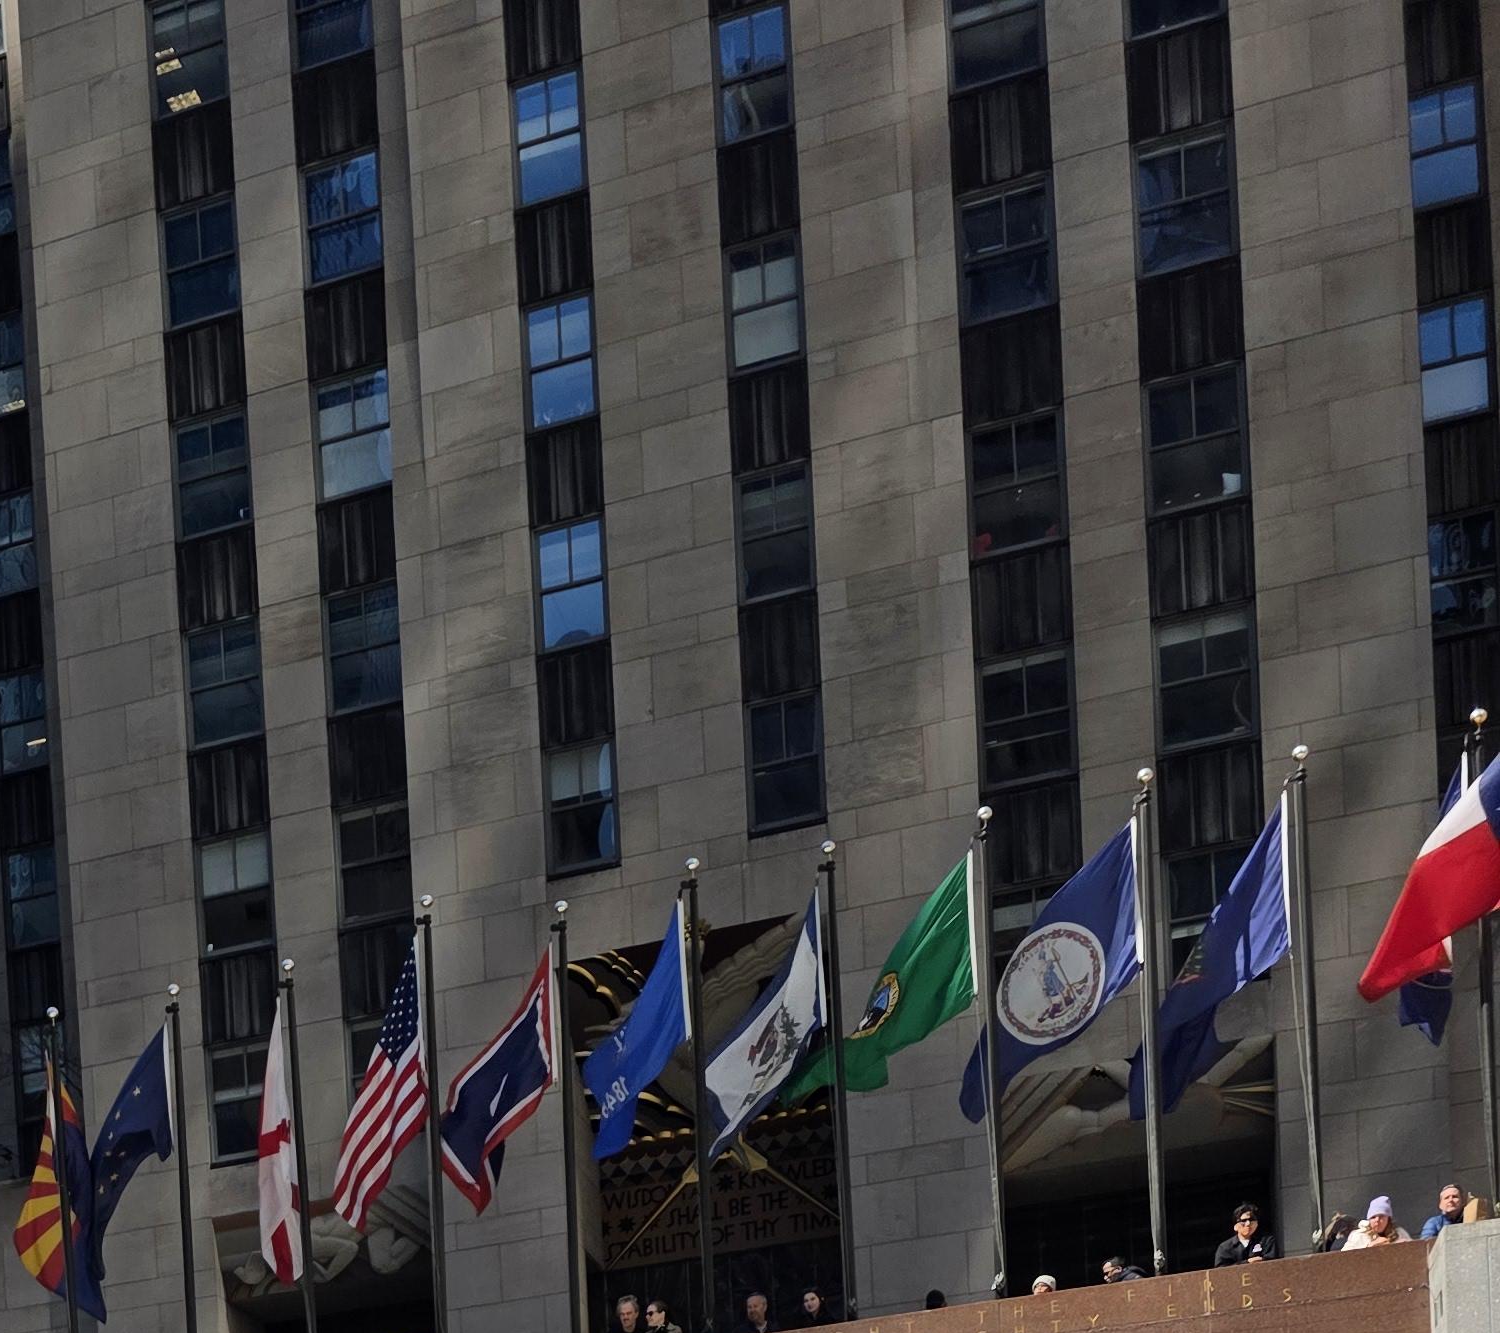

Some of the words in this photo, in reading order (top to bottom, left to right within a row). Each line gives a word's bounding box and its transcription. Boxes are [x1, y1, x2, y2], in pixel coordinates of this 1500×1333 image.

[602, 1183, 685, 1210] WISDO
[739, 1158, 836, 1189] KNWLED
[667, 1202, 723, 1228] SHAL
[729, 1196, 751, 1217] BE
[757, 1189, 788, 1212] THE
[604, 1230, 700, 1262] STABILITY
[711, 1224, 735, 1246] OF
[740, 1216, 780, 1241] THY
[788, 1212, 839, 1233] TIM
[977, 1300, 1060, 1324] THE
[1127, 1273, 1252, 1302] FIRE
[1166, 1288, 1292, 1317] ENDS
